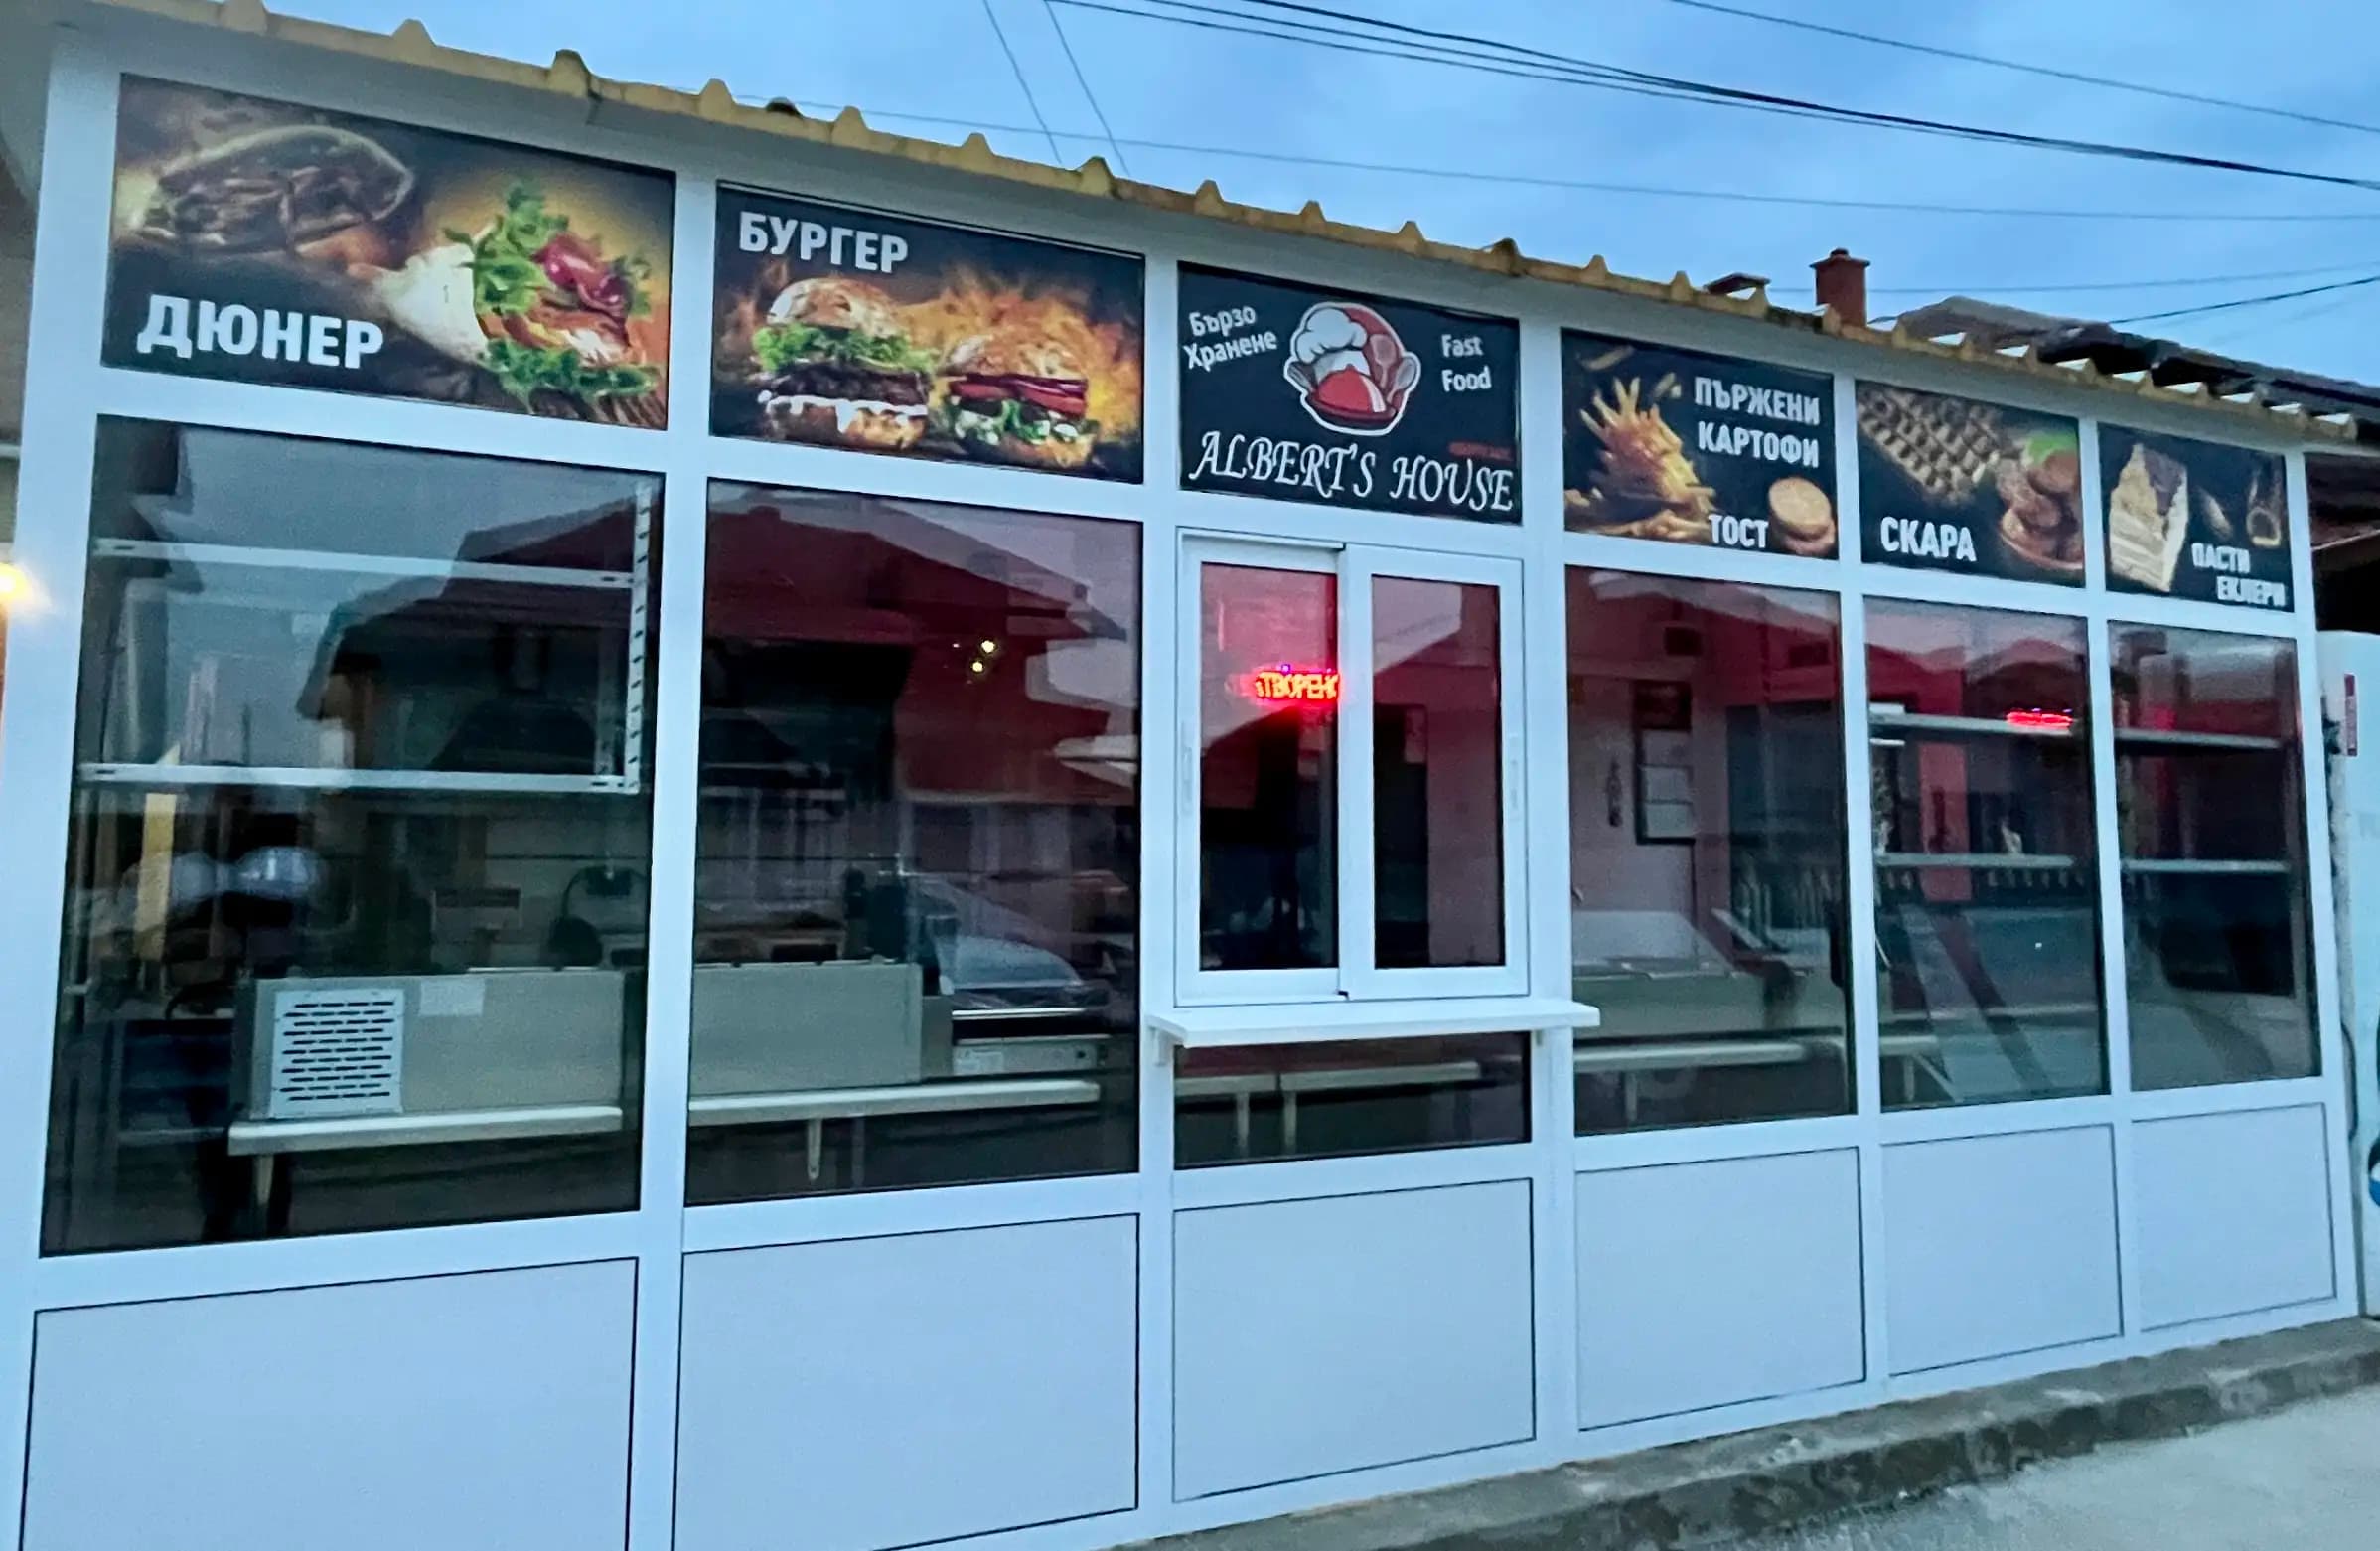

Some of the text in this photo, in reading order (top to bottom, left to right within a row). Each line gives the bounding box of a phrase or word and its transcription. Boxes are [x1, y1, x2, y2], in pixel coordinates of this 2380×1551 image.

[738, 211, 909, 274] БУРГЕР
[136, 294, 383, 369] ДЮНЕР
[1189, 306, 1257, 337] Бързо
[1184, 329, 1278, 372] Хранене
[1441, 334, 1484, 358] Fast
[1441, 366, 1491, 392] Food
[1694, 376, 1821, 426] ПЪРЖЕНИ
[1698, 421, 1820, 468] КАРТОФИ
[1188, 430, 1513, 512] ALBERT'S HOUSE
[1708, 514, 1769, 548] ТОСТ
[1880, 516, 1977, 562] СКАРА
